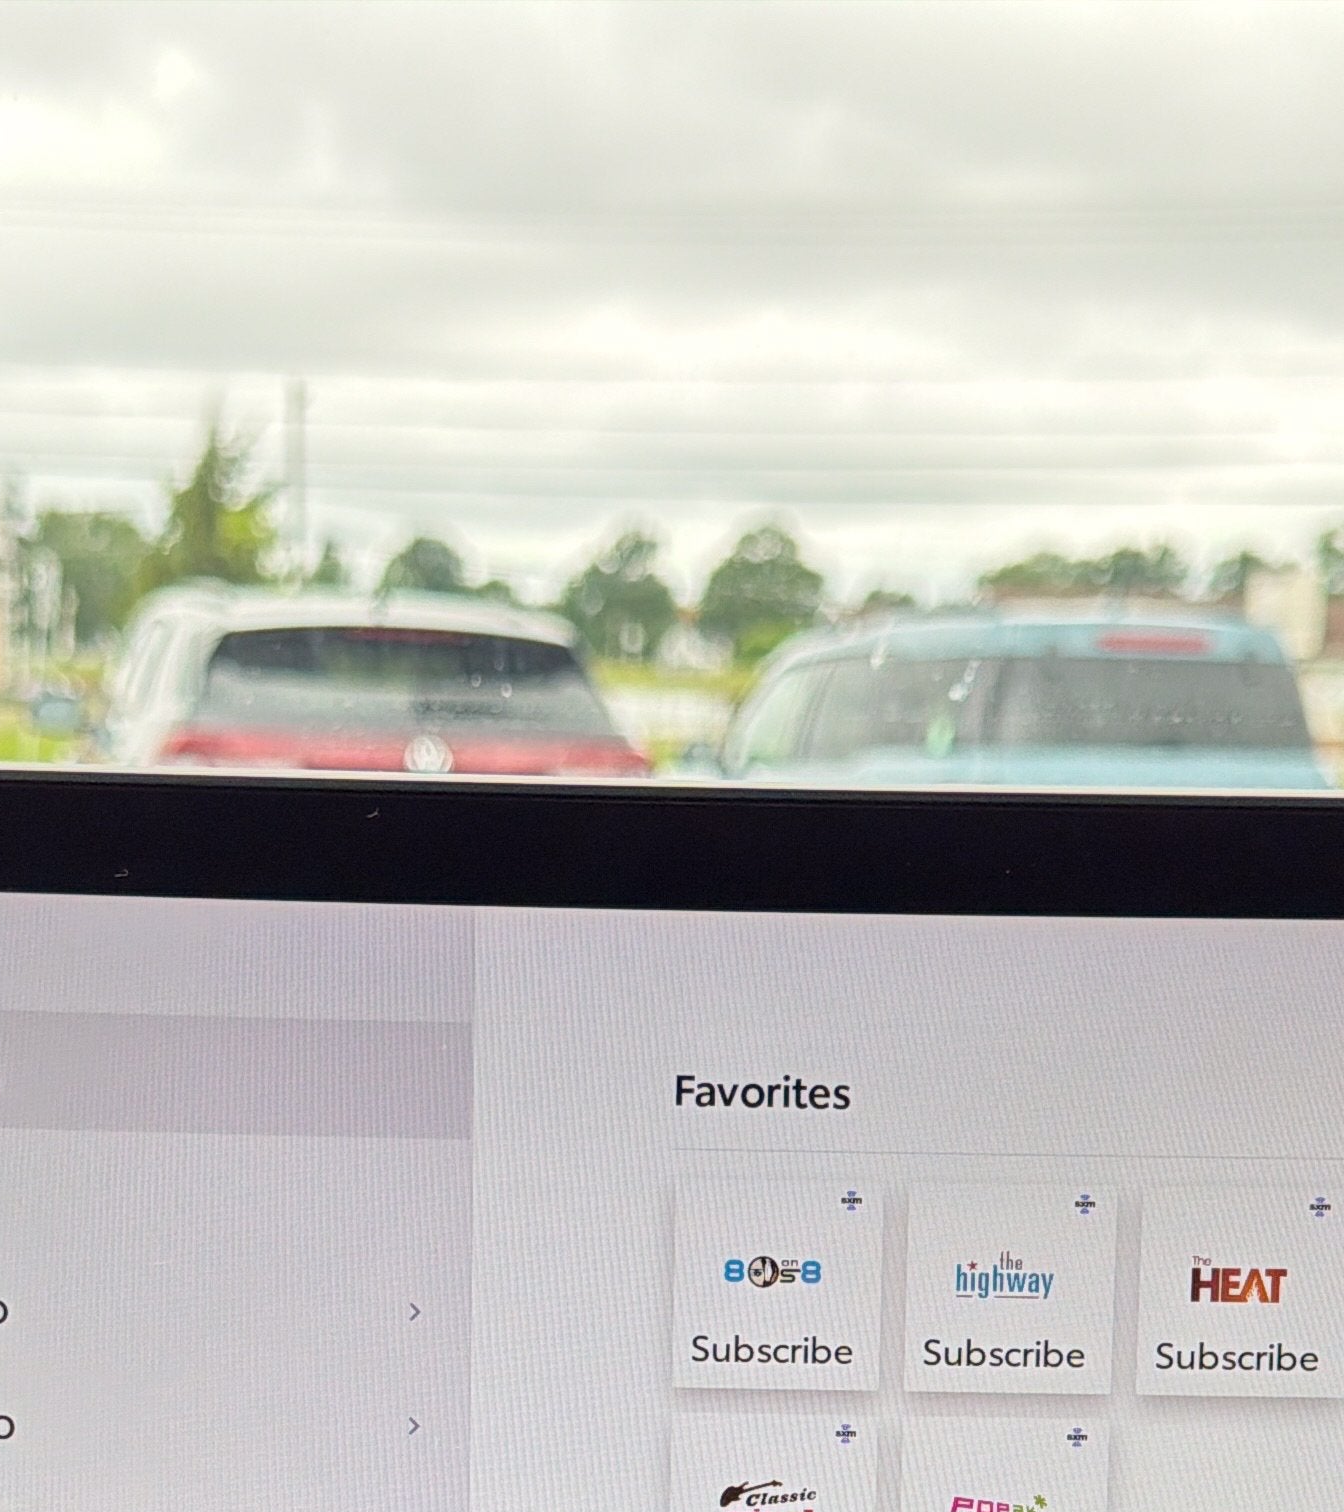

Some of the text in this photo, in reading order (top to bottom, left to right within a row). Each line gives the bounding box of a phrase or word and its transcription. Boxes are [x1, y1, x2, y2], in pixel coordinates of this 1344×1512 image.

[676, 1075, 850, 1109] Favorites
[1000, 1251, 1022, 1270] the
[1191, 1255, 1213, 1267] The
[956, 1263, 1054, 1298] highway
[1189, 1267, 1288, 1303] HEAT
[692, 1335, 852, 1364] Subscribe
[924, 1339, 1084, 1367] Subscribe
[1156, 1342, 1318, 1371] Subscribe
[744, 1486, 818, 1508] Classic
